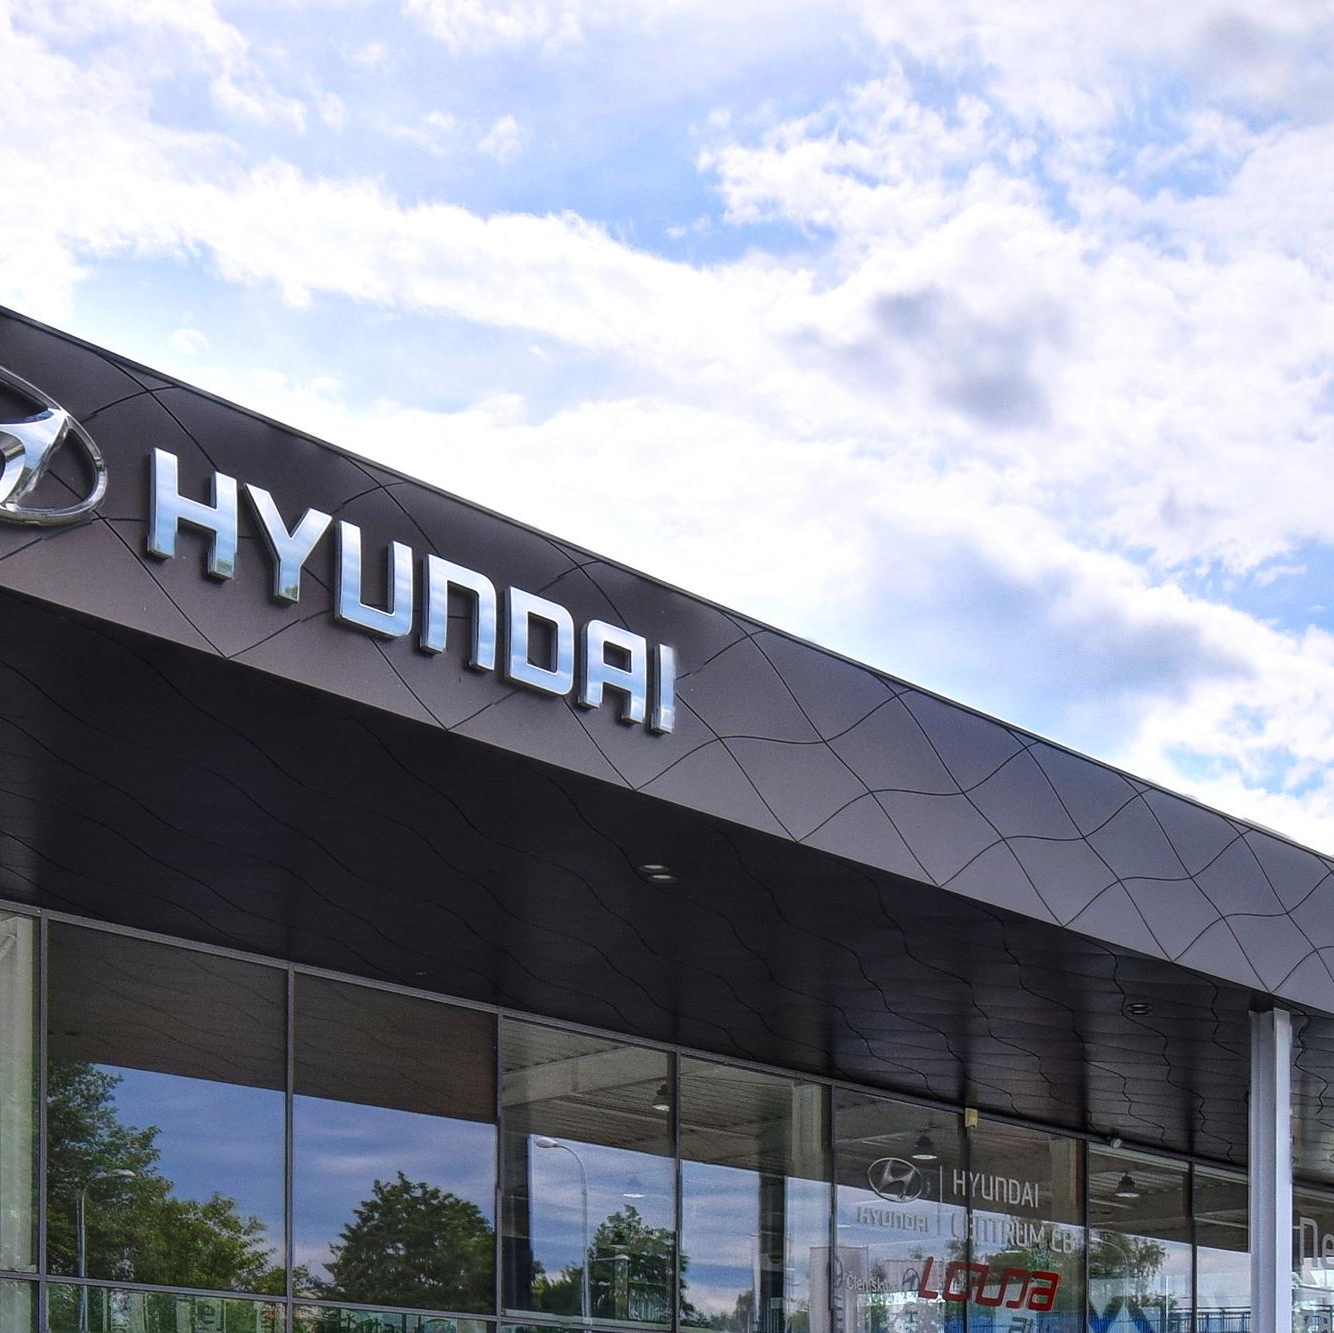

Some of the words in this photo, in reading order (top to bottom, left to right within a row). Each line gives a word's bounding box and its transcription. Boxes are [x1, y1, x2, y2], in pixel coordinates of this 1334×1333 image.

[146, 447, 677, 735] HYUNDAI
[953, 1168, 1039, 1208] HYUNDAI
[857, 1206, 928, 1233] HYUNDAI
